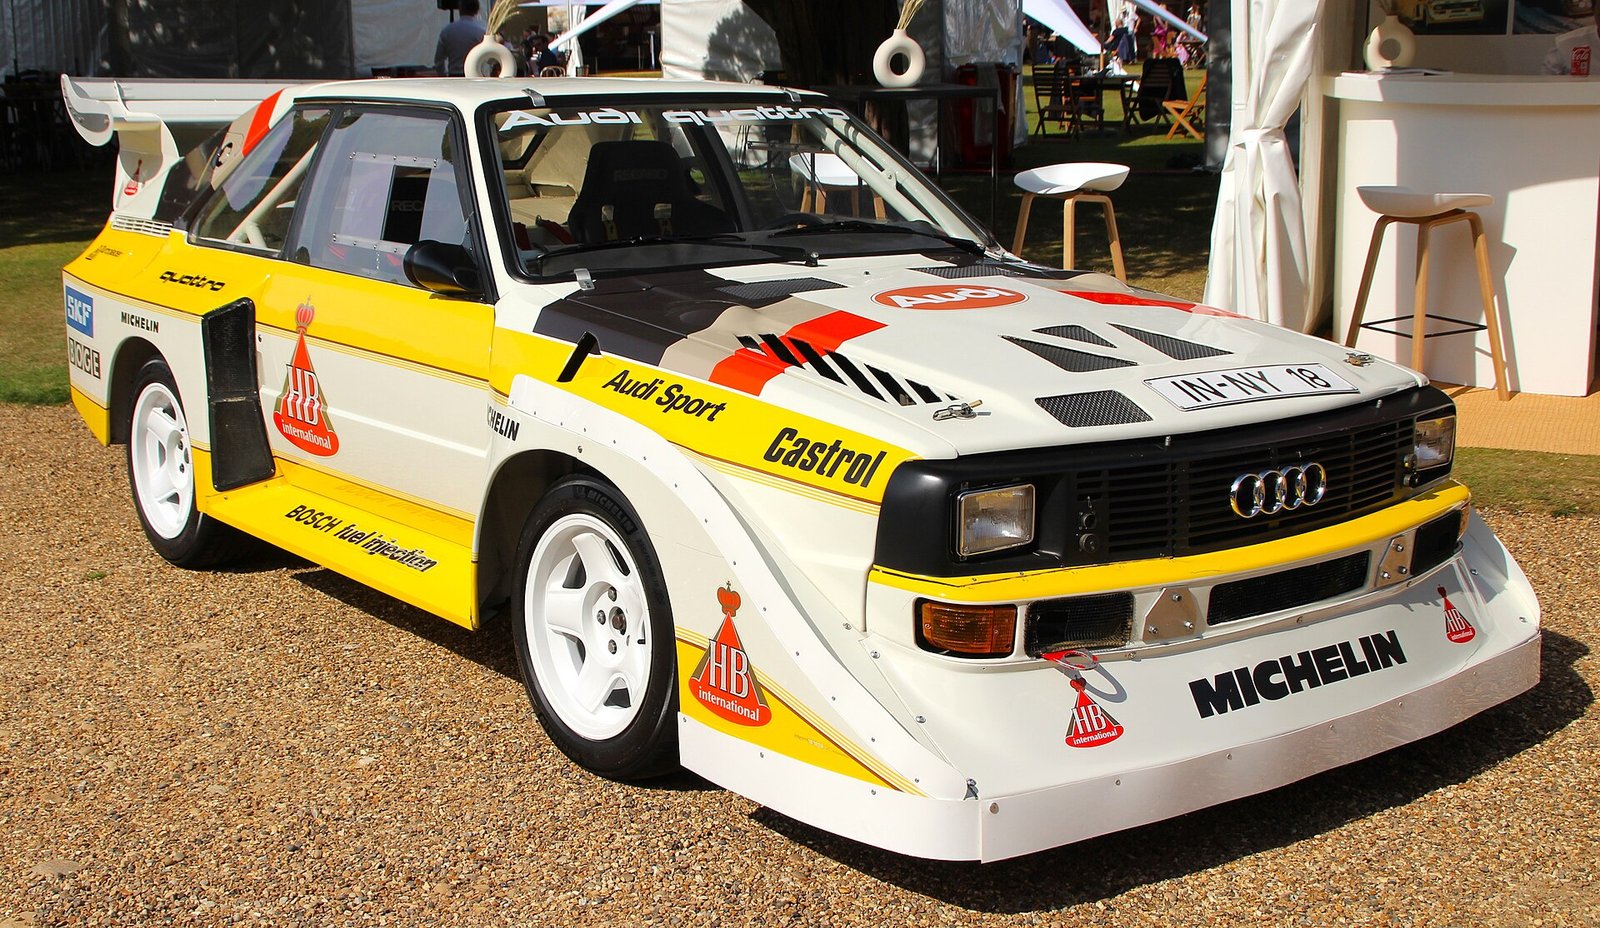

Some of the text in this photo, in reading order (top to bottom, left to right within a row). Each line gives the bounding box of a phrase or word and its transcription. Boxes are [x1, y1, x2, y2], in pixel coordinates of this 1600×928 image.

[499, 106, 850, 131] Audi quattro
[159, 271, 225, 291] quattro
[67, 294, 92, 327] SKF
[887, 288, 1016, 308] Audi
[121, 311, 159, 333] MICHELIN
[69, 337, 100, 379] BOGE
[286, 364, 320, 426] HB
[602, 370, 727, 422] Audi Sport
[1171, 368, 1331, 402] IN-NY 18
[281, 419, 332, 450] international
[763, 427, 887, 488] Castrol
[285, 505, 342, 533] BOSCH
[334, 524, 376, 546] fuel
[362, 535, 437, 572] injection
[1443, 609, 1466, 632] HB
[709, 639, 749, 699] HB
[1188, 630, 1407, 719] MICHELIN
[699, 686, 759, 721] international
[1071, 703, 1107, 735] HB
[1073, 728, 1118, 745] international
